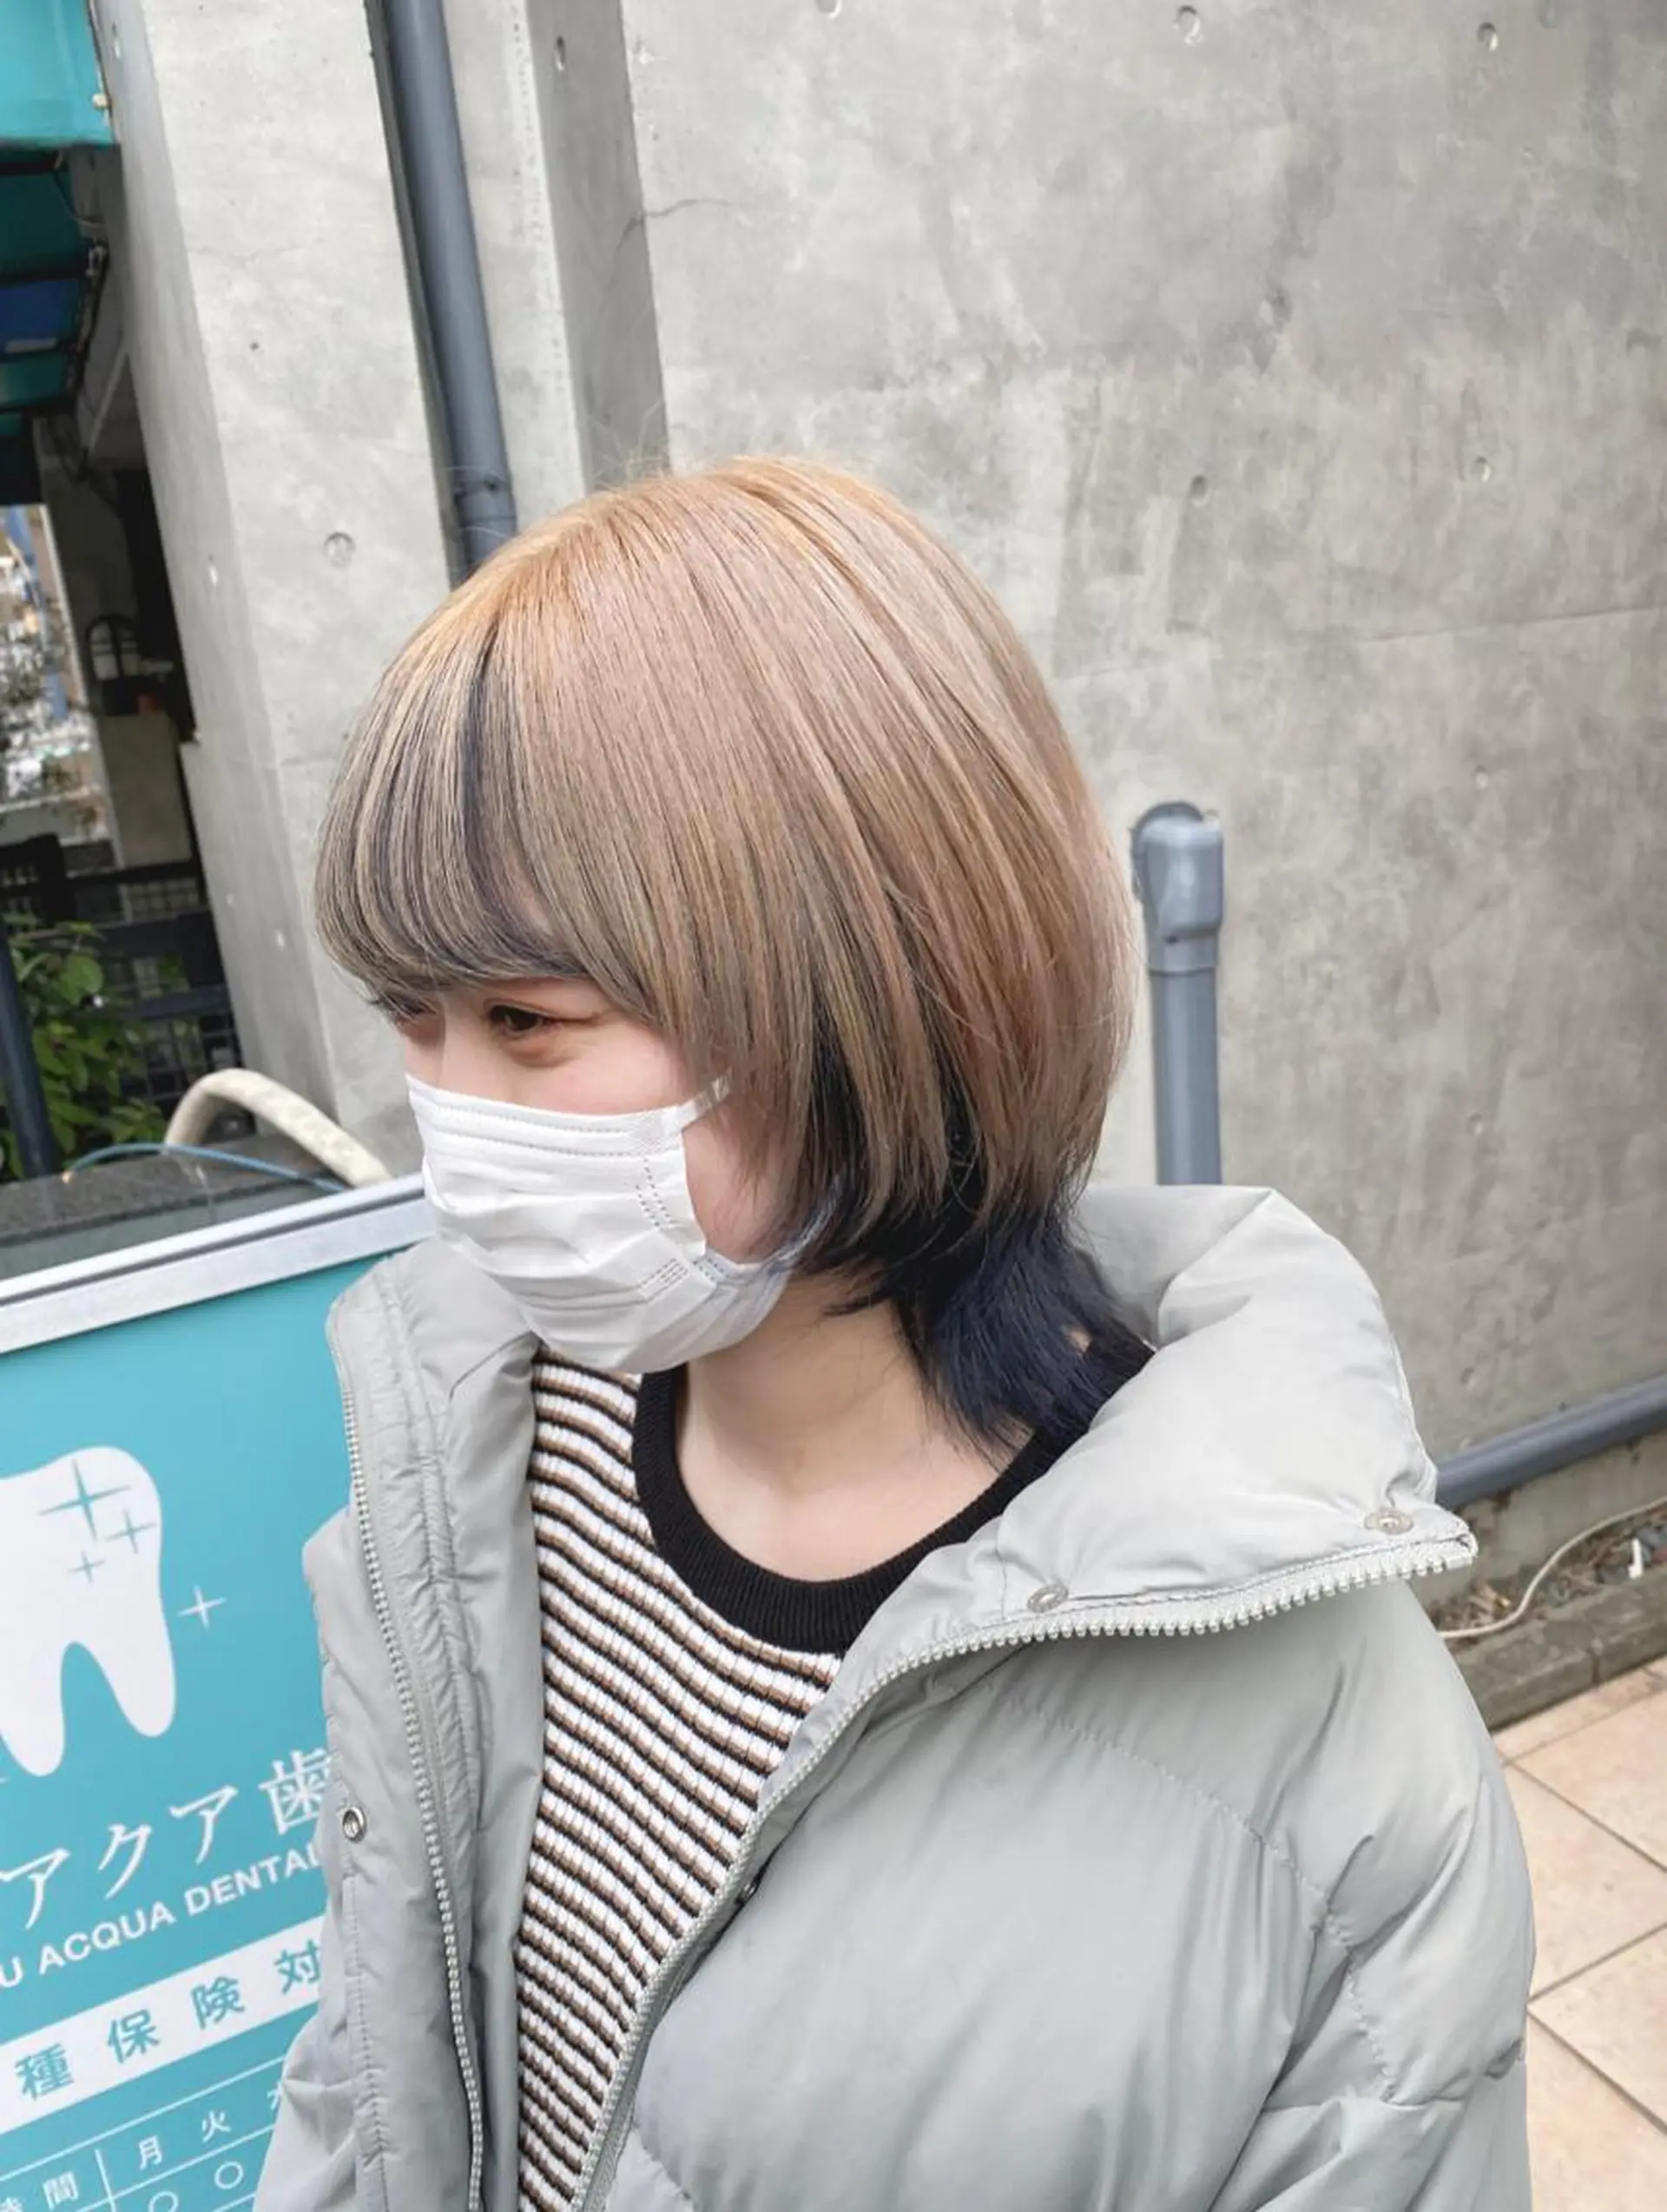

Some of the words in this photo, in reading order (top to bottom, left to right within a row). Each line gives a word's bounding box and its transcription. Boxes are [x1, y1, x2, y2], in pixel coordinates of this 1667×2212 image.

[39, 1901, 176, 1975] ACQUA
[138, 2136, 163, 2169] 月
[201, 2110, 231, 2142] 火
